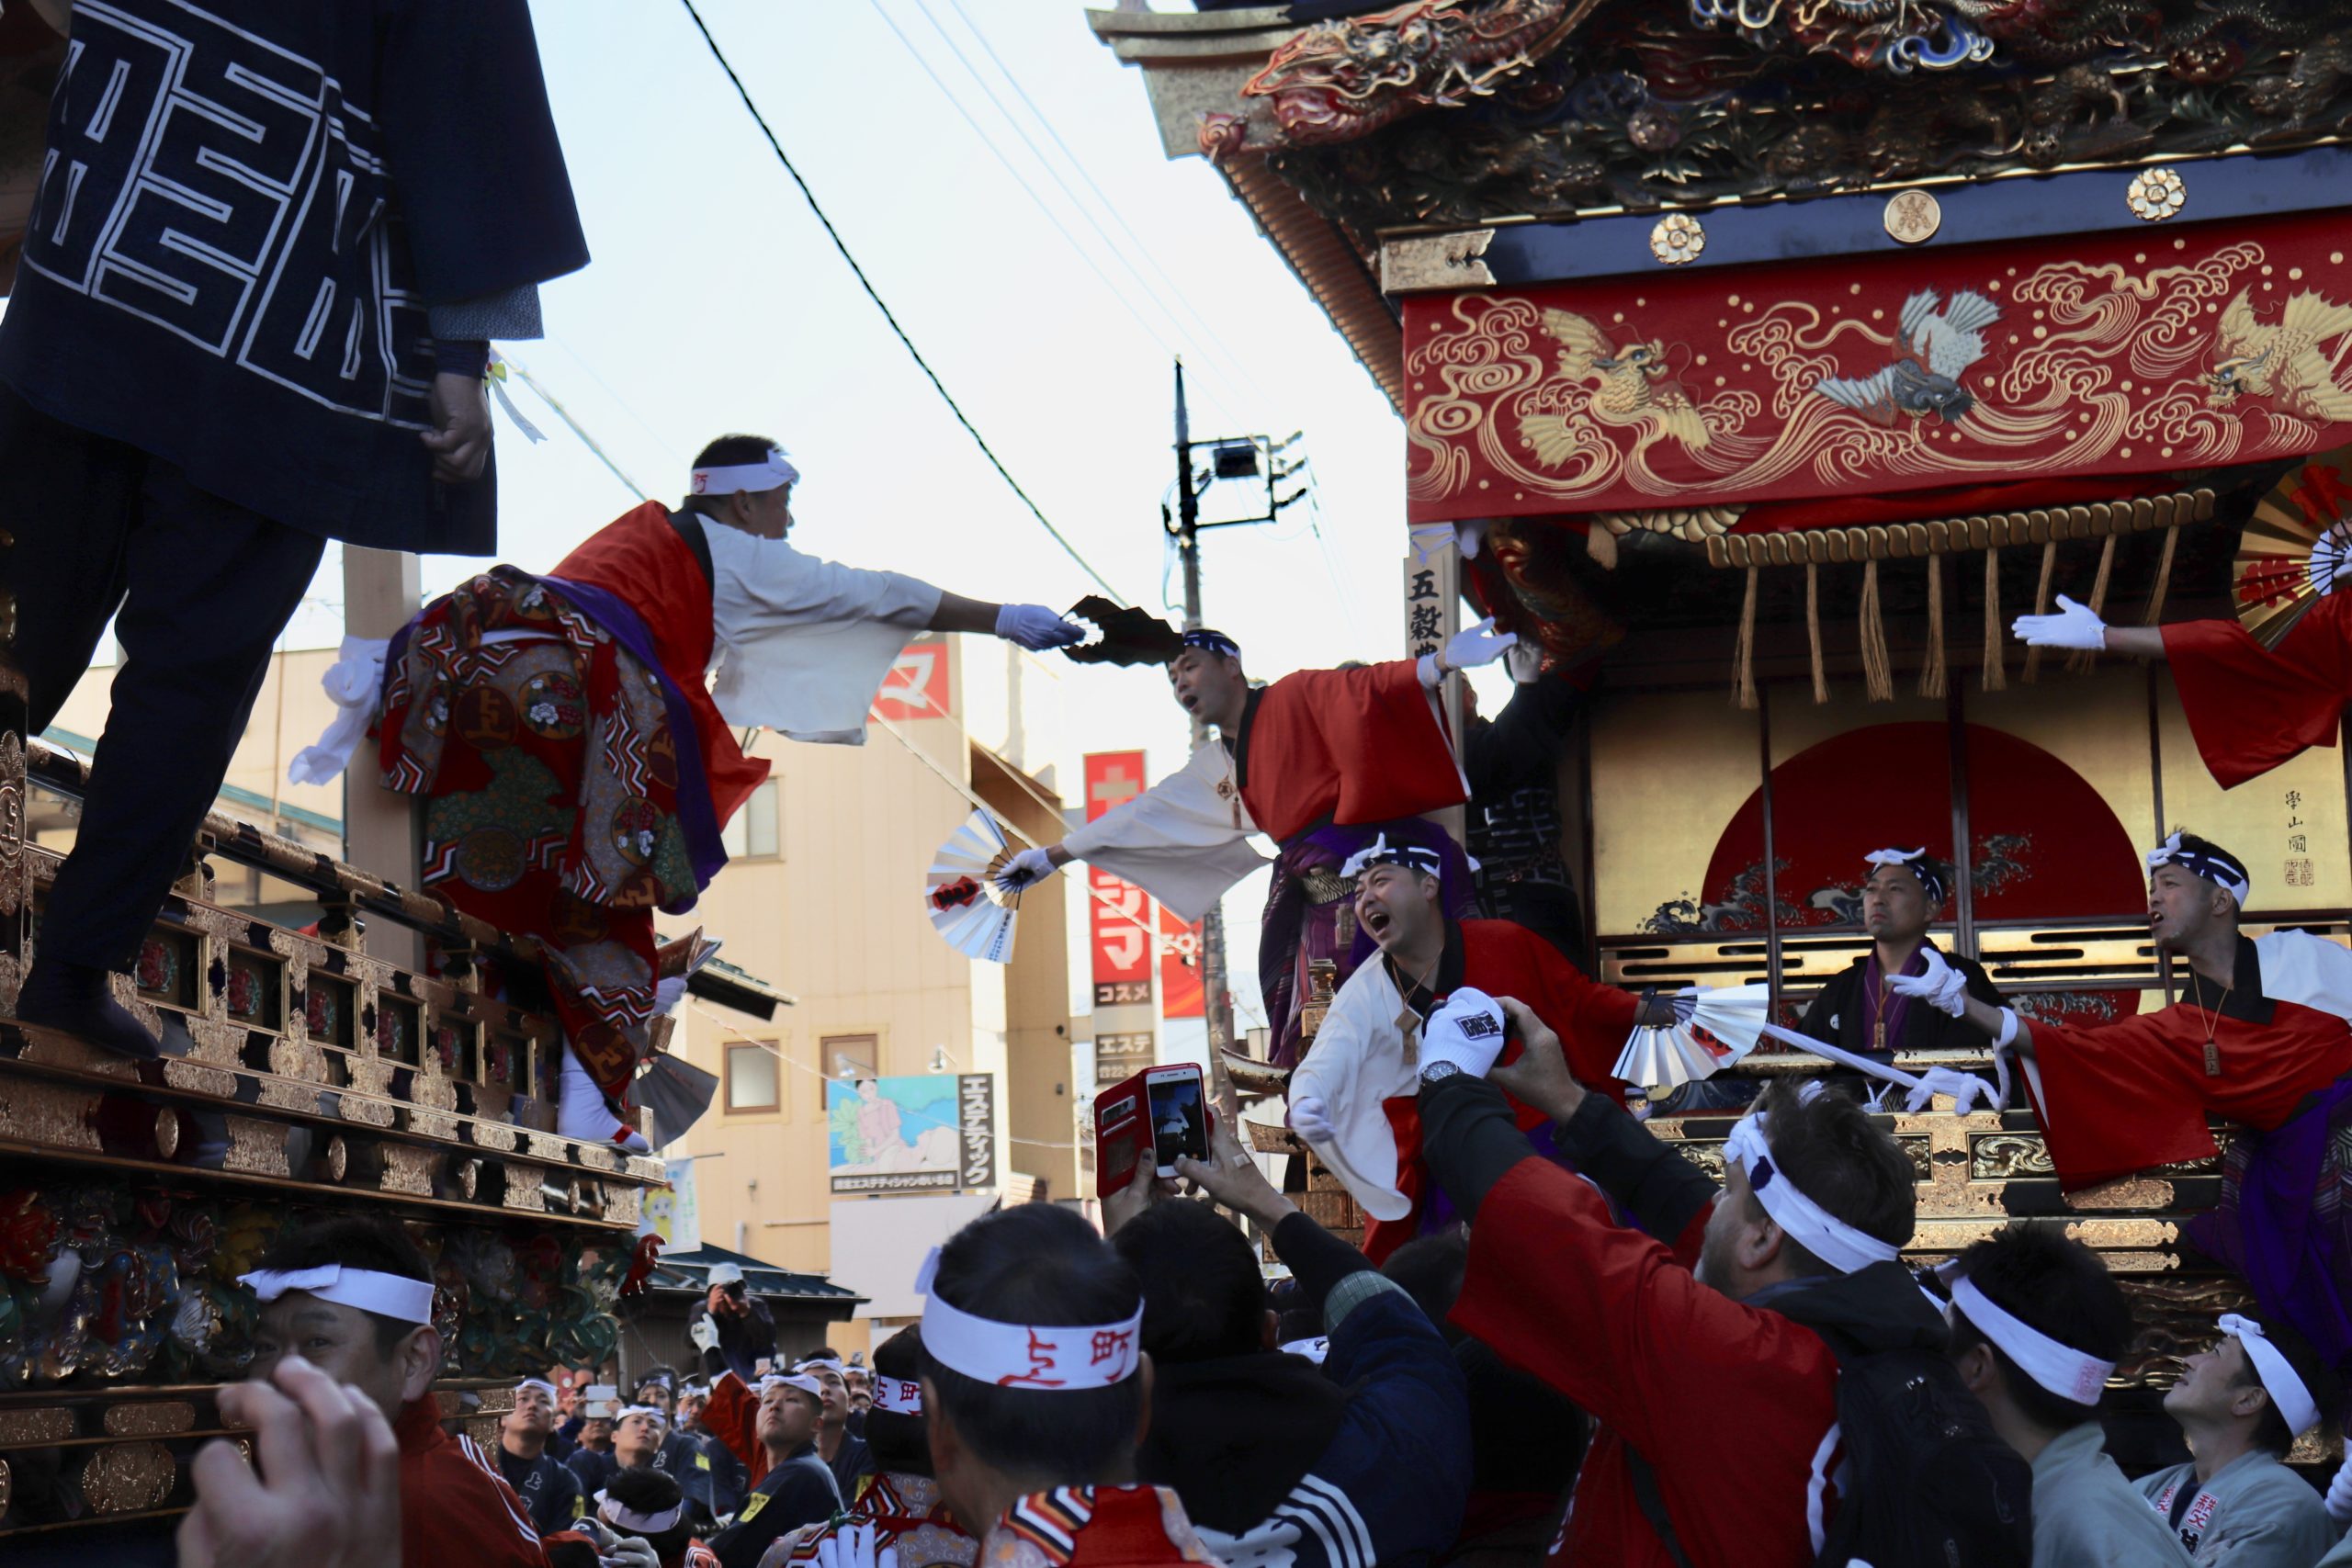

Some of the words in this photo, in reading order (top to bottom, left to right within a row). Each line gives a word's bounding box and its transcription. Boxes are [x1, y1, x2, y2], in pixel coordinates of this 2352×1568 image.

[1098, 983, 1149, 1003] コスメ
[1098, 1034, 1150, 1055] エステ
[962, 1077, 990, 1186] エステティック
